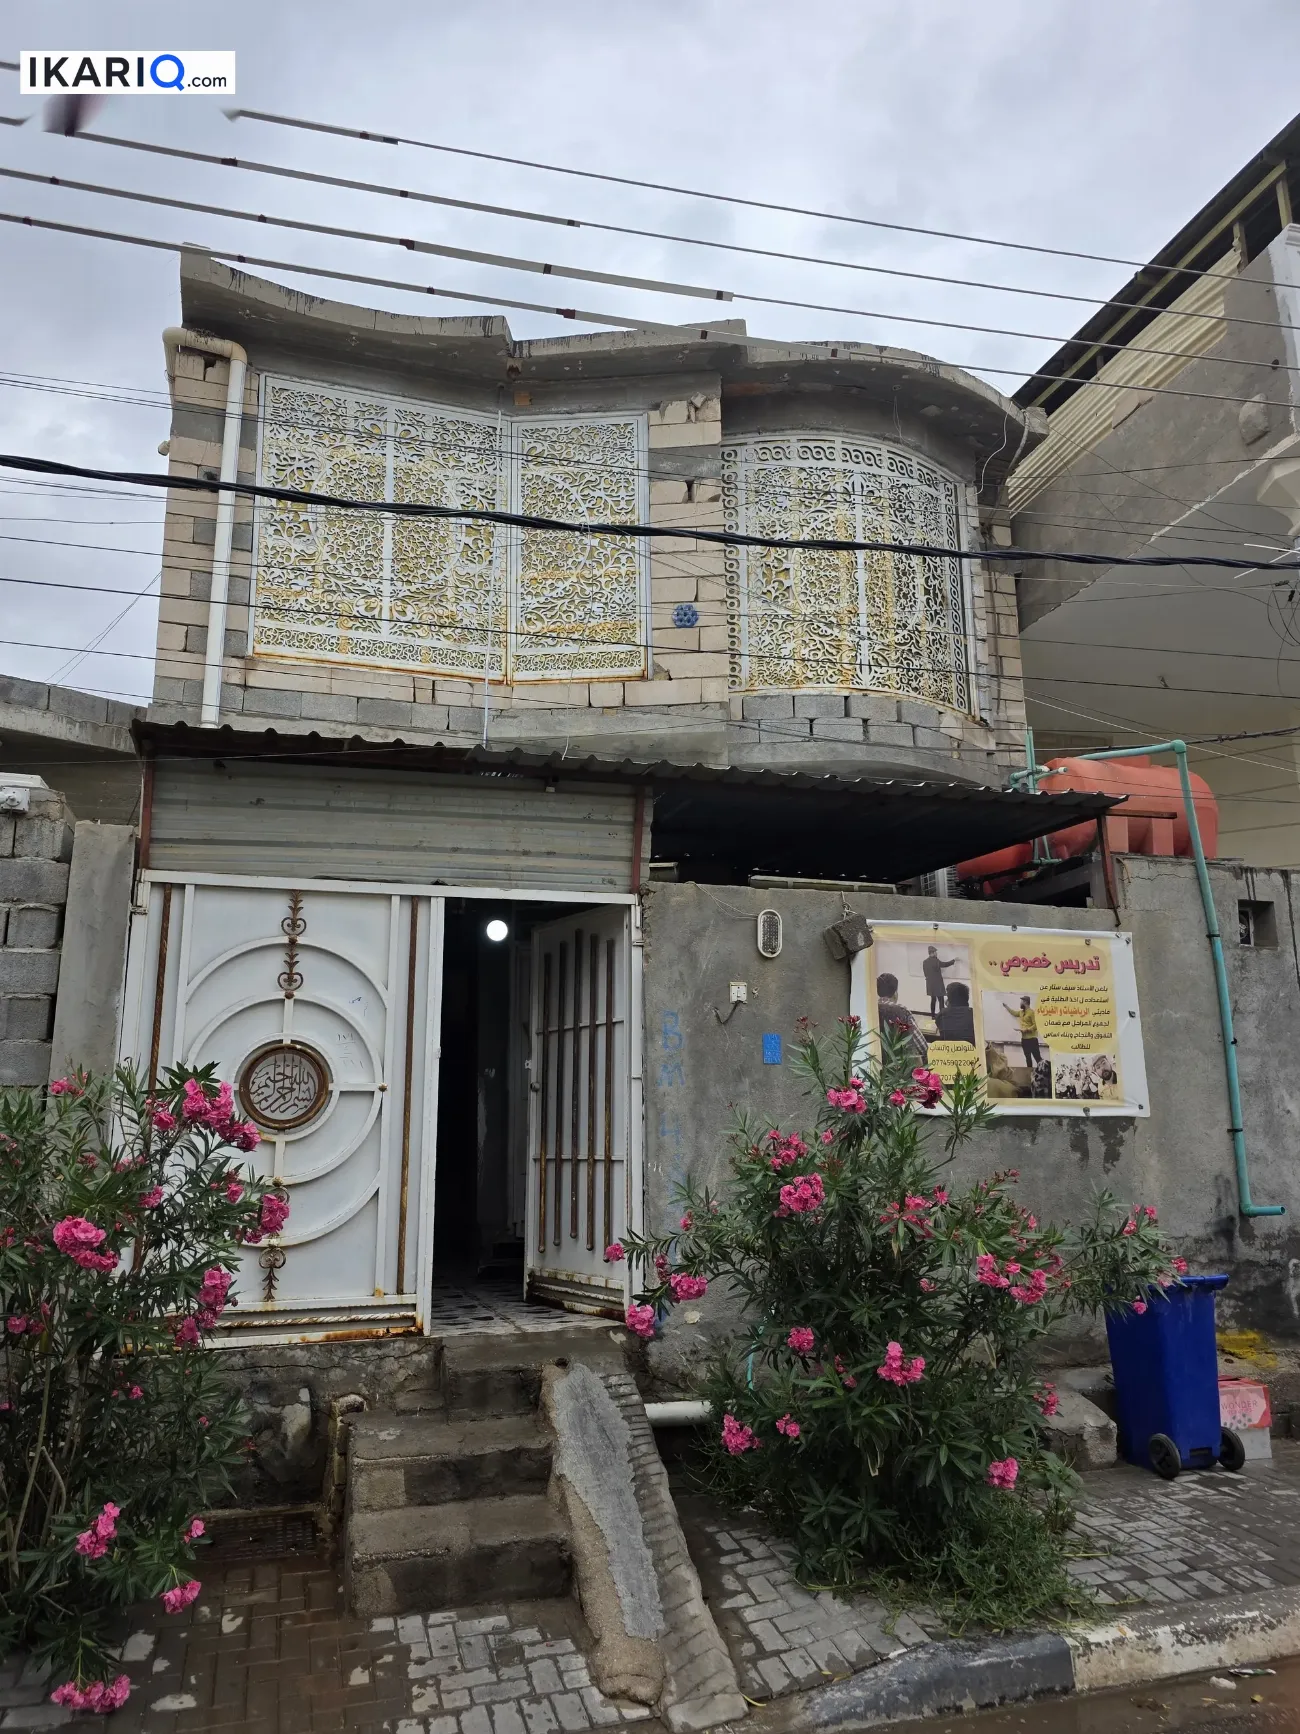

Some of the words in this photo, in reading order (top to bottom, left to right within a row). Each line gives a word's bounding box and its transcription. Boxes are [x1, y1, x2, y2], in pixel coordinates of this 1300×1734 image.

[1000, 952, 1051, 976] خصوصي
[1055, 955, 1100, 974] تدريس
[1049, 984, 1061, 992] ستار
[1062, 984, 1076, 992] سيف
[1040, 995, 1050, 1004] في
[1051, 996, 1068, 1004] الطلبة
[1037, 1005, 1058, 1016] الفيزياء
[1062, 1006, 1089, 1017] الرياضيات
[1094, 1032, 1113, 1040] التفوق
[951, 1044, 975, 1053] للتواصل
[1070, 1043, 1091, 1051] للطالب
[1221, 1400, 1258, 1410] WONDER
